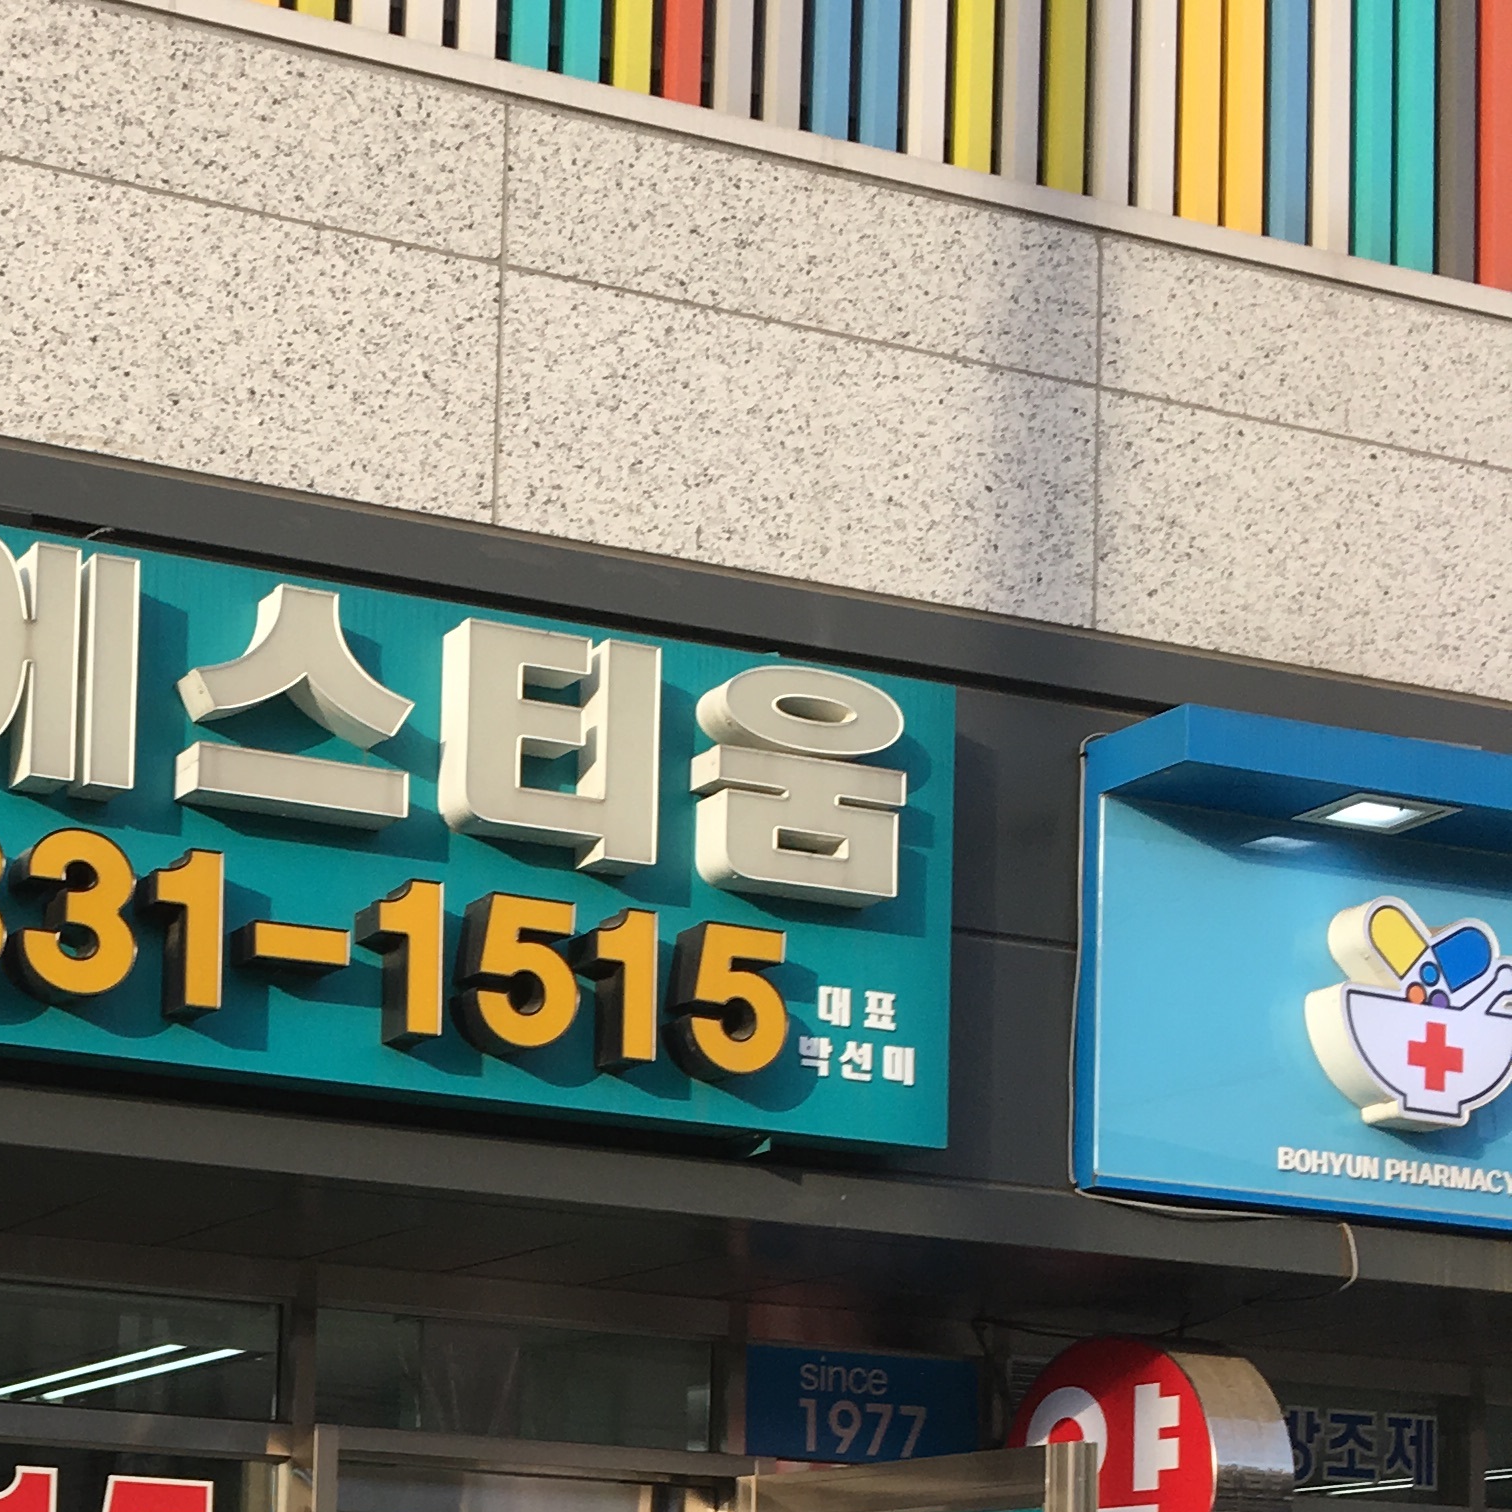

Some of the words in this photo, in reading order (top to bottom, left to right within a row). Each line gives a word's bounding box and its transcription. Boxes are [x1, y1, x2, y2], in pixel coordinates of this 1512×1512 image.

[817, 985, 897, 1032] 대표
[798, 1035, 916, 1087] 박선미
[1277, 1146, 1380, 1181] BOHYUN
[1384, 1158, 1512, 1196] PHARMACY
[799, 1355, 889, 1396] since
[799, 1397, 928, 1459] 1977
